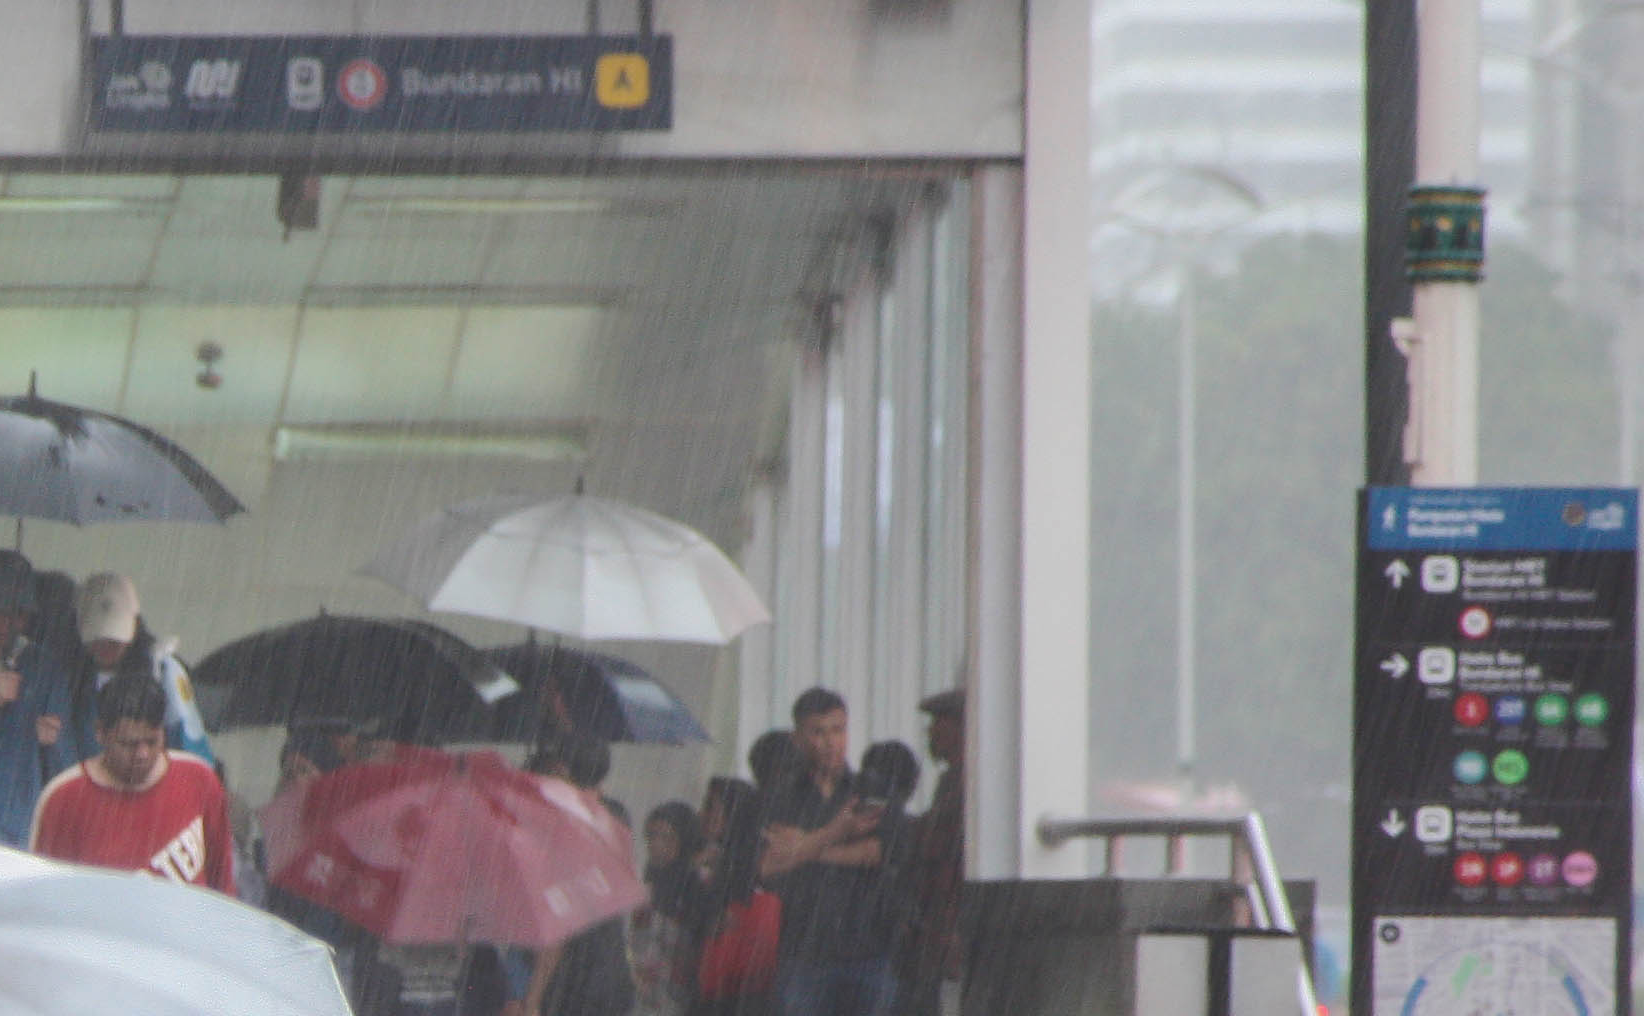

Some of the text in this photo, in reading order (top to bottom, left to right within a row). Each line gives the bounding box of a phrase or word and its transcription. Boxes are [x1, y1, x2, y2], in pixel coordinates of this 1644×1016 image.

[402, 67, 631, 97] Bundaran HI A
